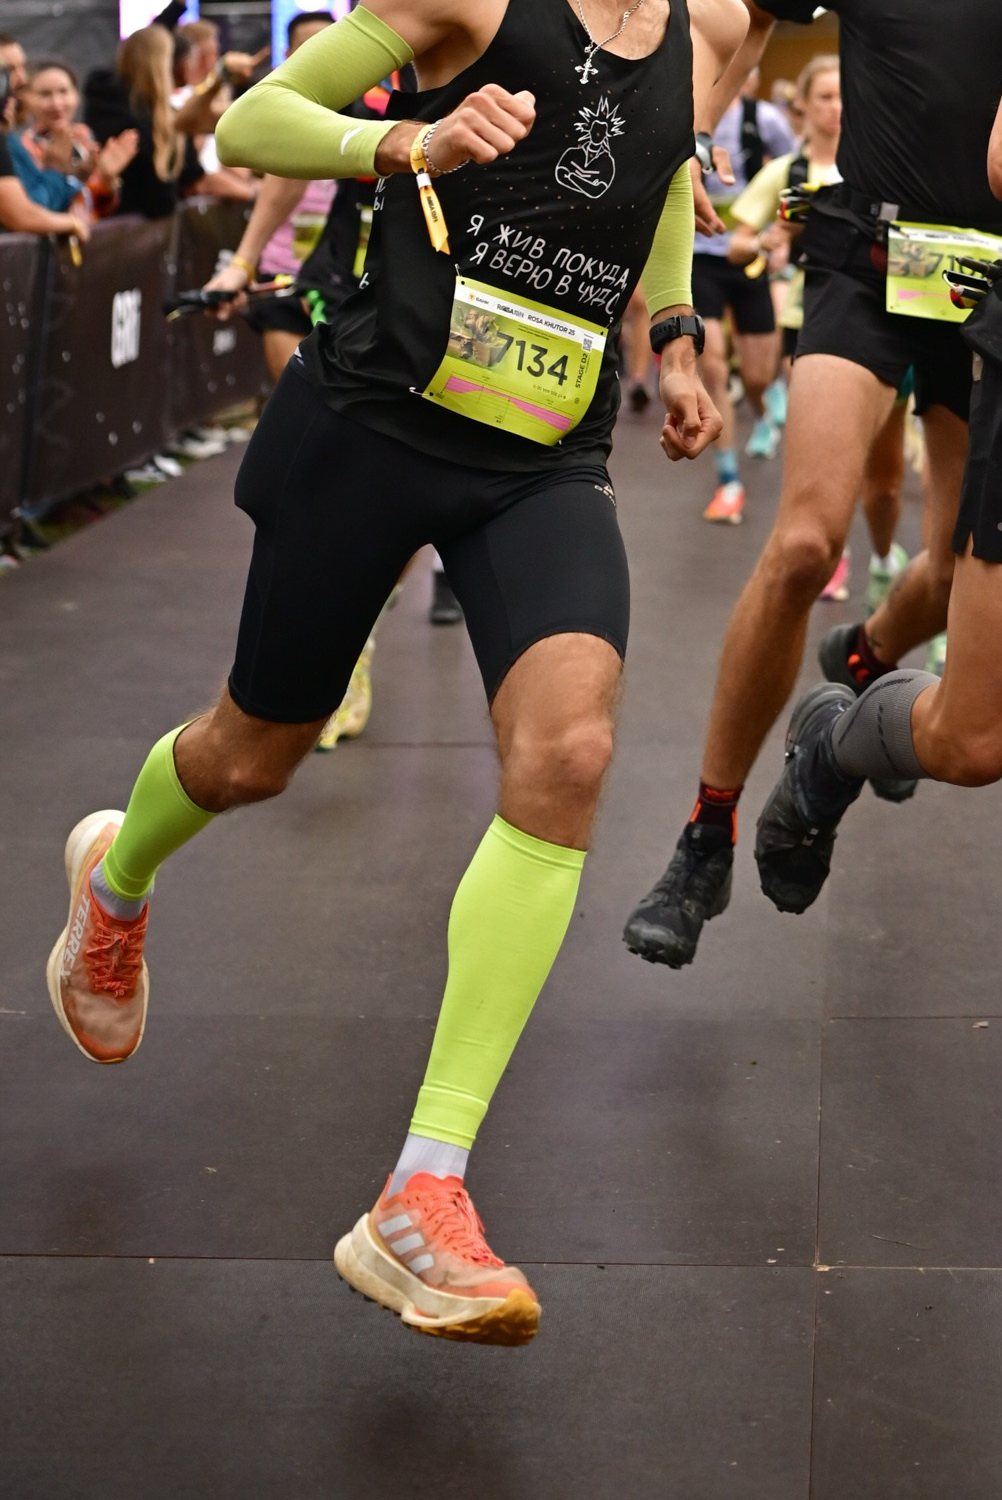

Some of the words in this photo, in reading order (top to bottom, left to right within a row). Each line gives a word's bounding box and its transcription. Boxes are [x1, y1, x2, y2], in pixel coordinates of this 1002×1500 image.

[466, 214, 484, 236] Я
[492, 223, 546, 259] ЖИВ
[469, 242, 489, 265] Я
[489, 249, 553, 290] ВЕРЮ
[554, 274, 573, 296] В
[493, 331, 568, 386] 7134
[59, 894, 91, 986] TERREX
